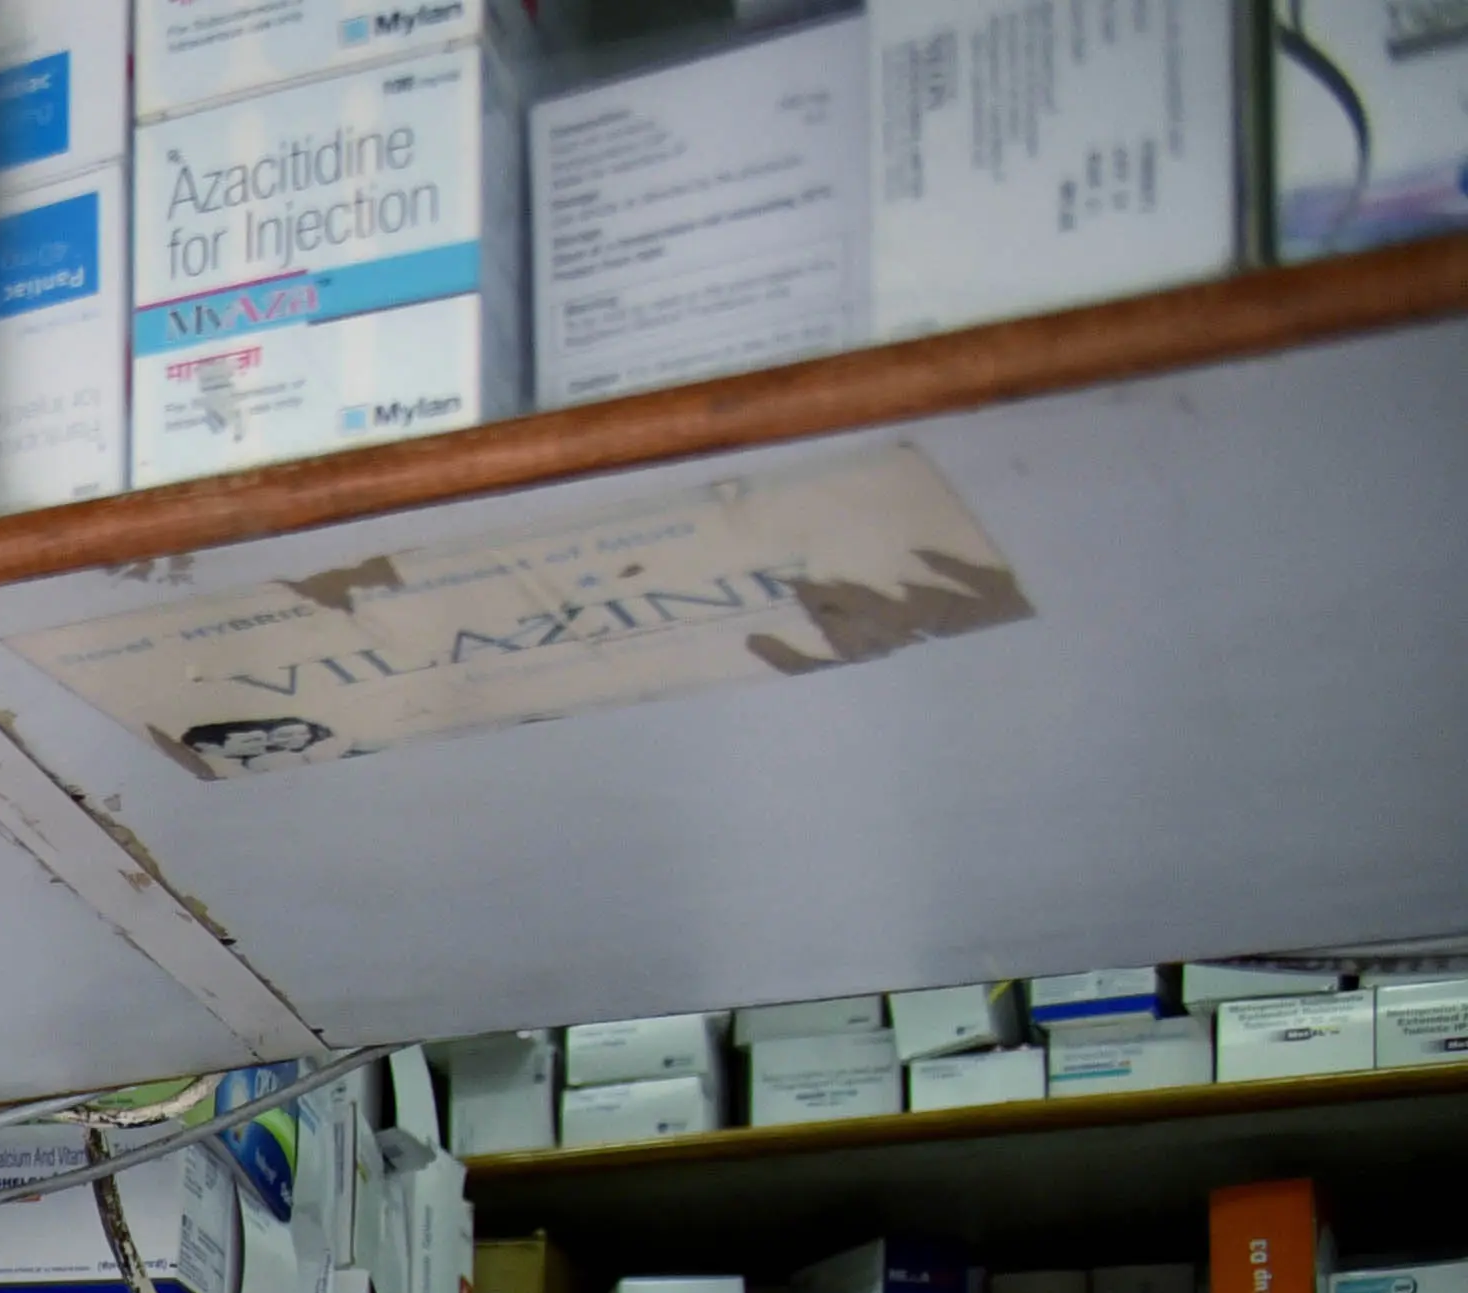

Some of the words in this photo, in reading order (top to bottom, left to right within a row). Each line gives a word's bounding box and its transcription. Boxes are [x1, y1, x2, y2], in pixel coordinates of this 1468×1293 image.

[167, 124, 415, 220] Azacitidine
[168, 234, 227, 281] for
[245, 180, 438, 267] Injection
[374, 391, 462, 429] Mylan
[34, 1148, 55, 1167] And
